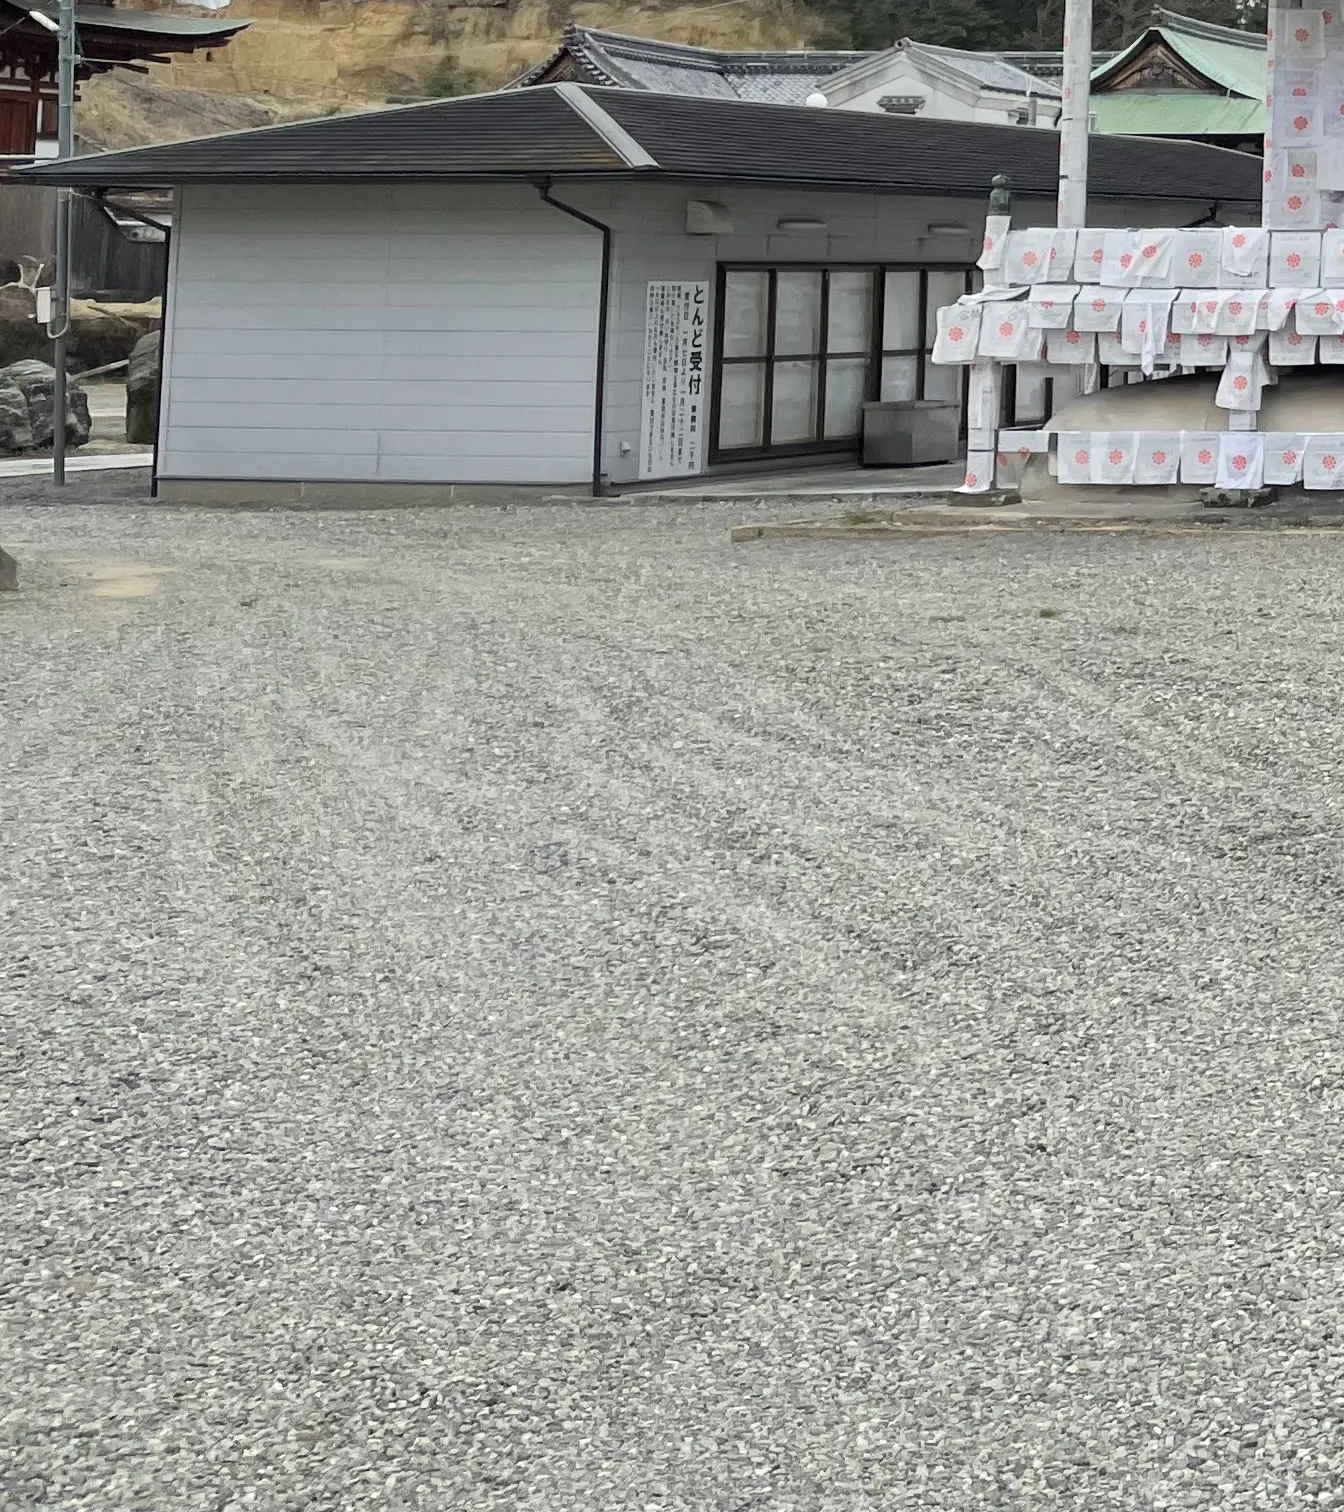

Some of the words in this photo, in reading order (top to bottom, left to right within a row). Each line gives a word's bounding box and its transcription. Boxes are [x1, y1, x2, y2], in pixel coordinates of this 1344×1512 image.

[688, 284, 705, 396] とんど受付
